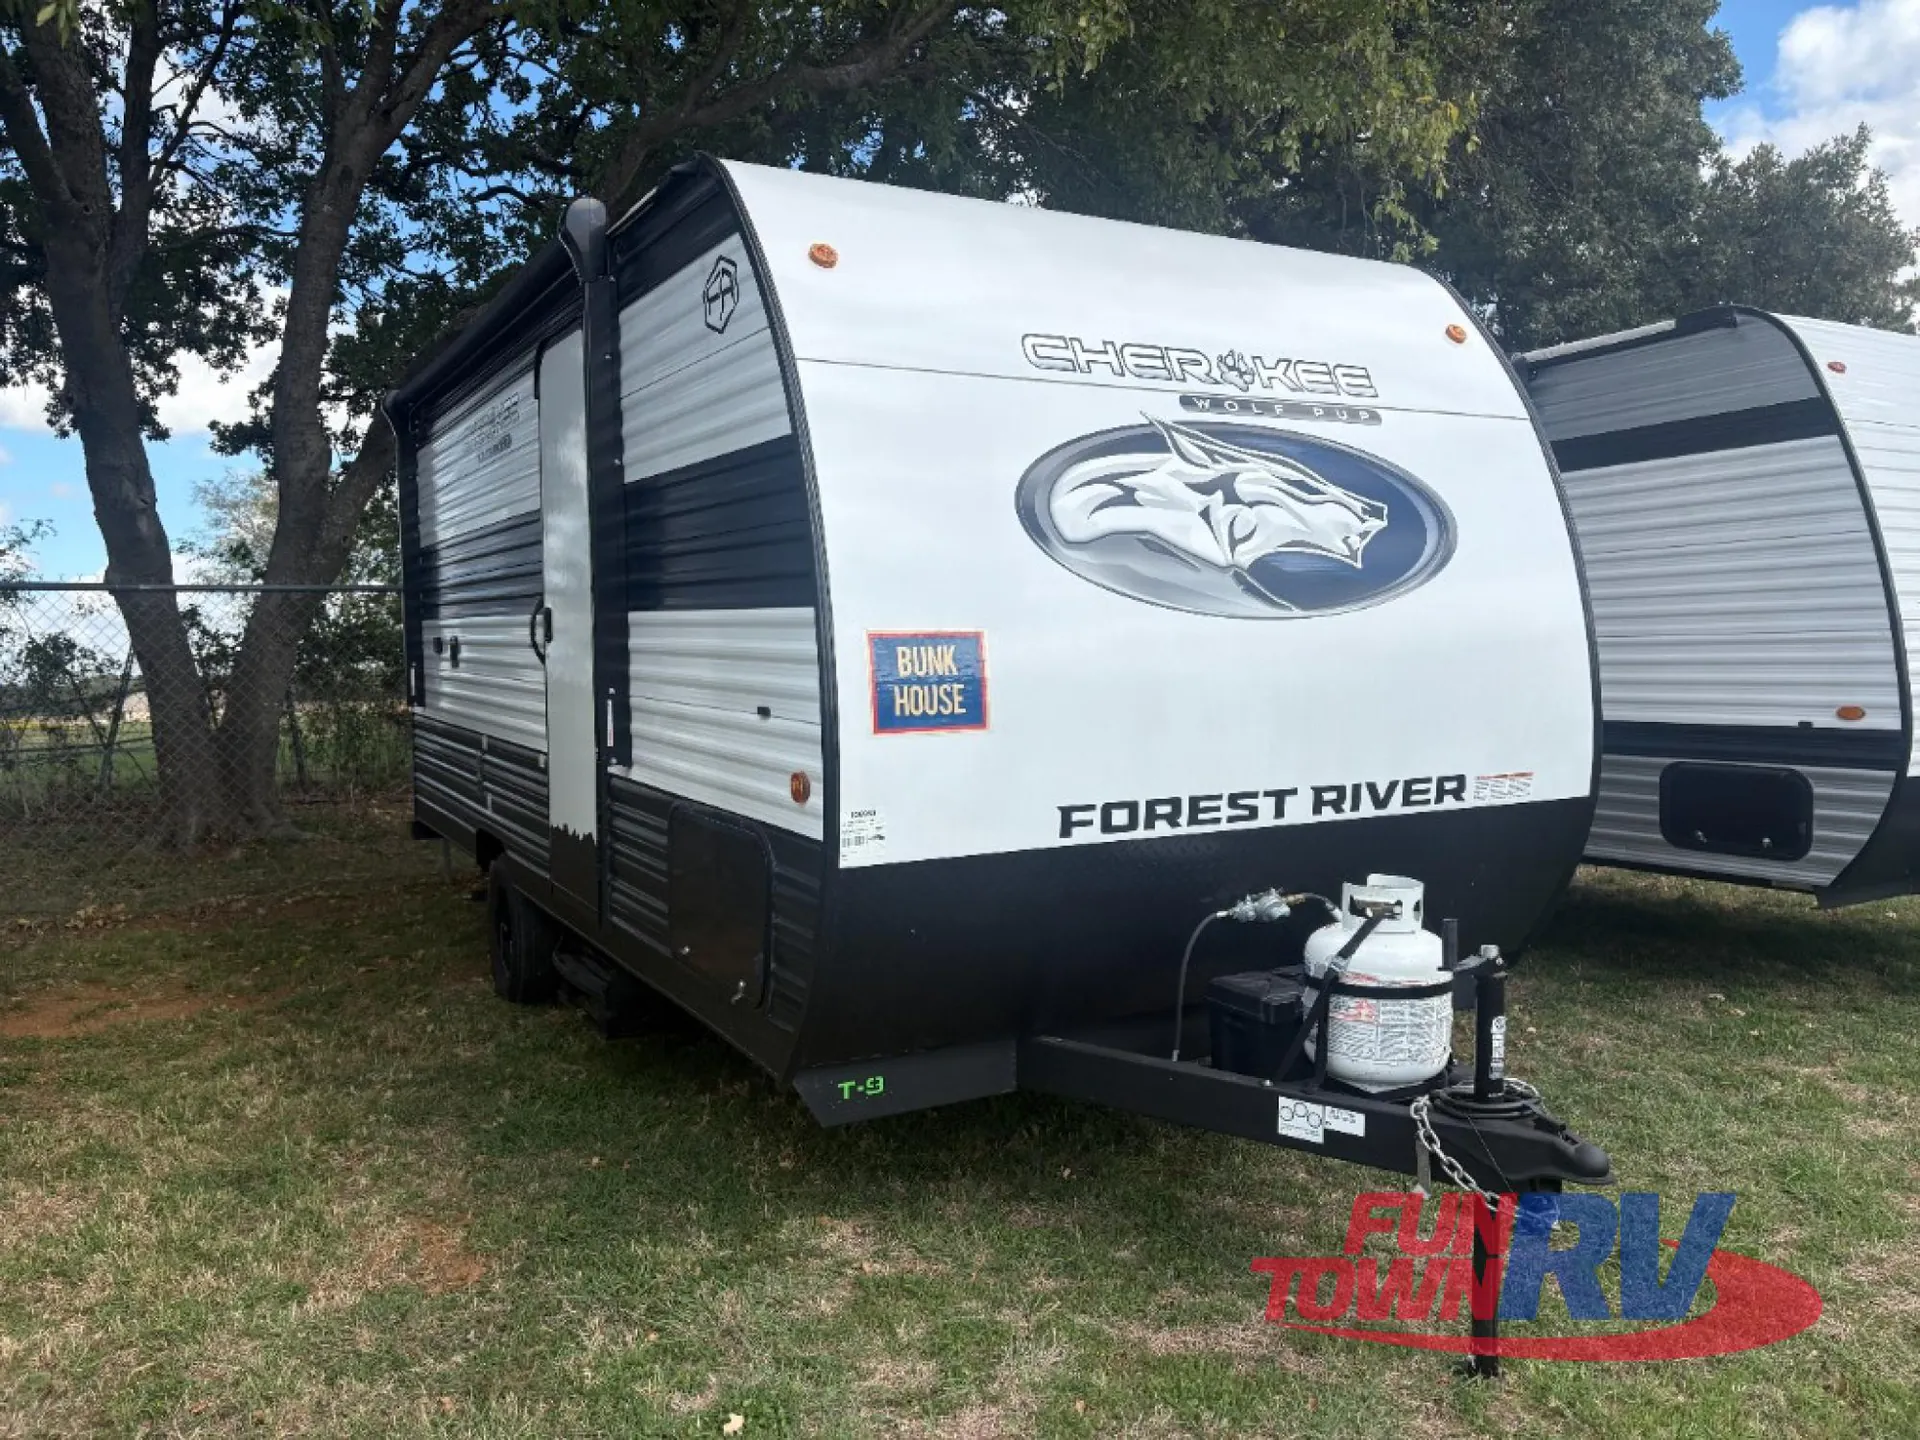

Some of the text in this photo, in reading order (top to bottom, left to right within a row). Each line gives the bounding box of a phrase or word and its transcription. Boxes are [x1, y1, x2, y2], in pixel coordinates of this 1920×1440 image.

[1192, 396, 1371, 421] WOLF PUP
[896, 644, 959, 678] BUNK
[893, 683, 967, 717] HOUSE
[1057, 787, 1299, 838] FOREST
[1310, 774, 1467, 817] RIVER
